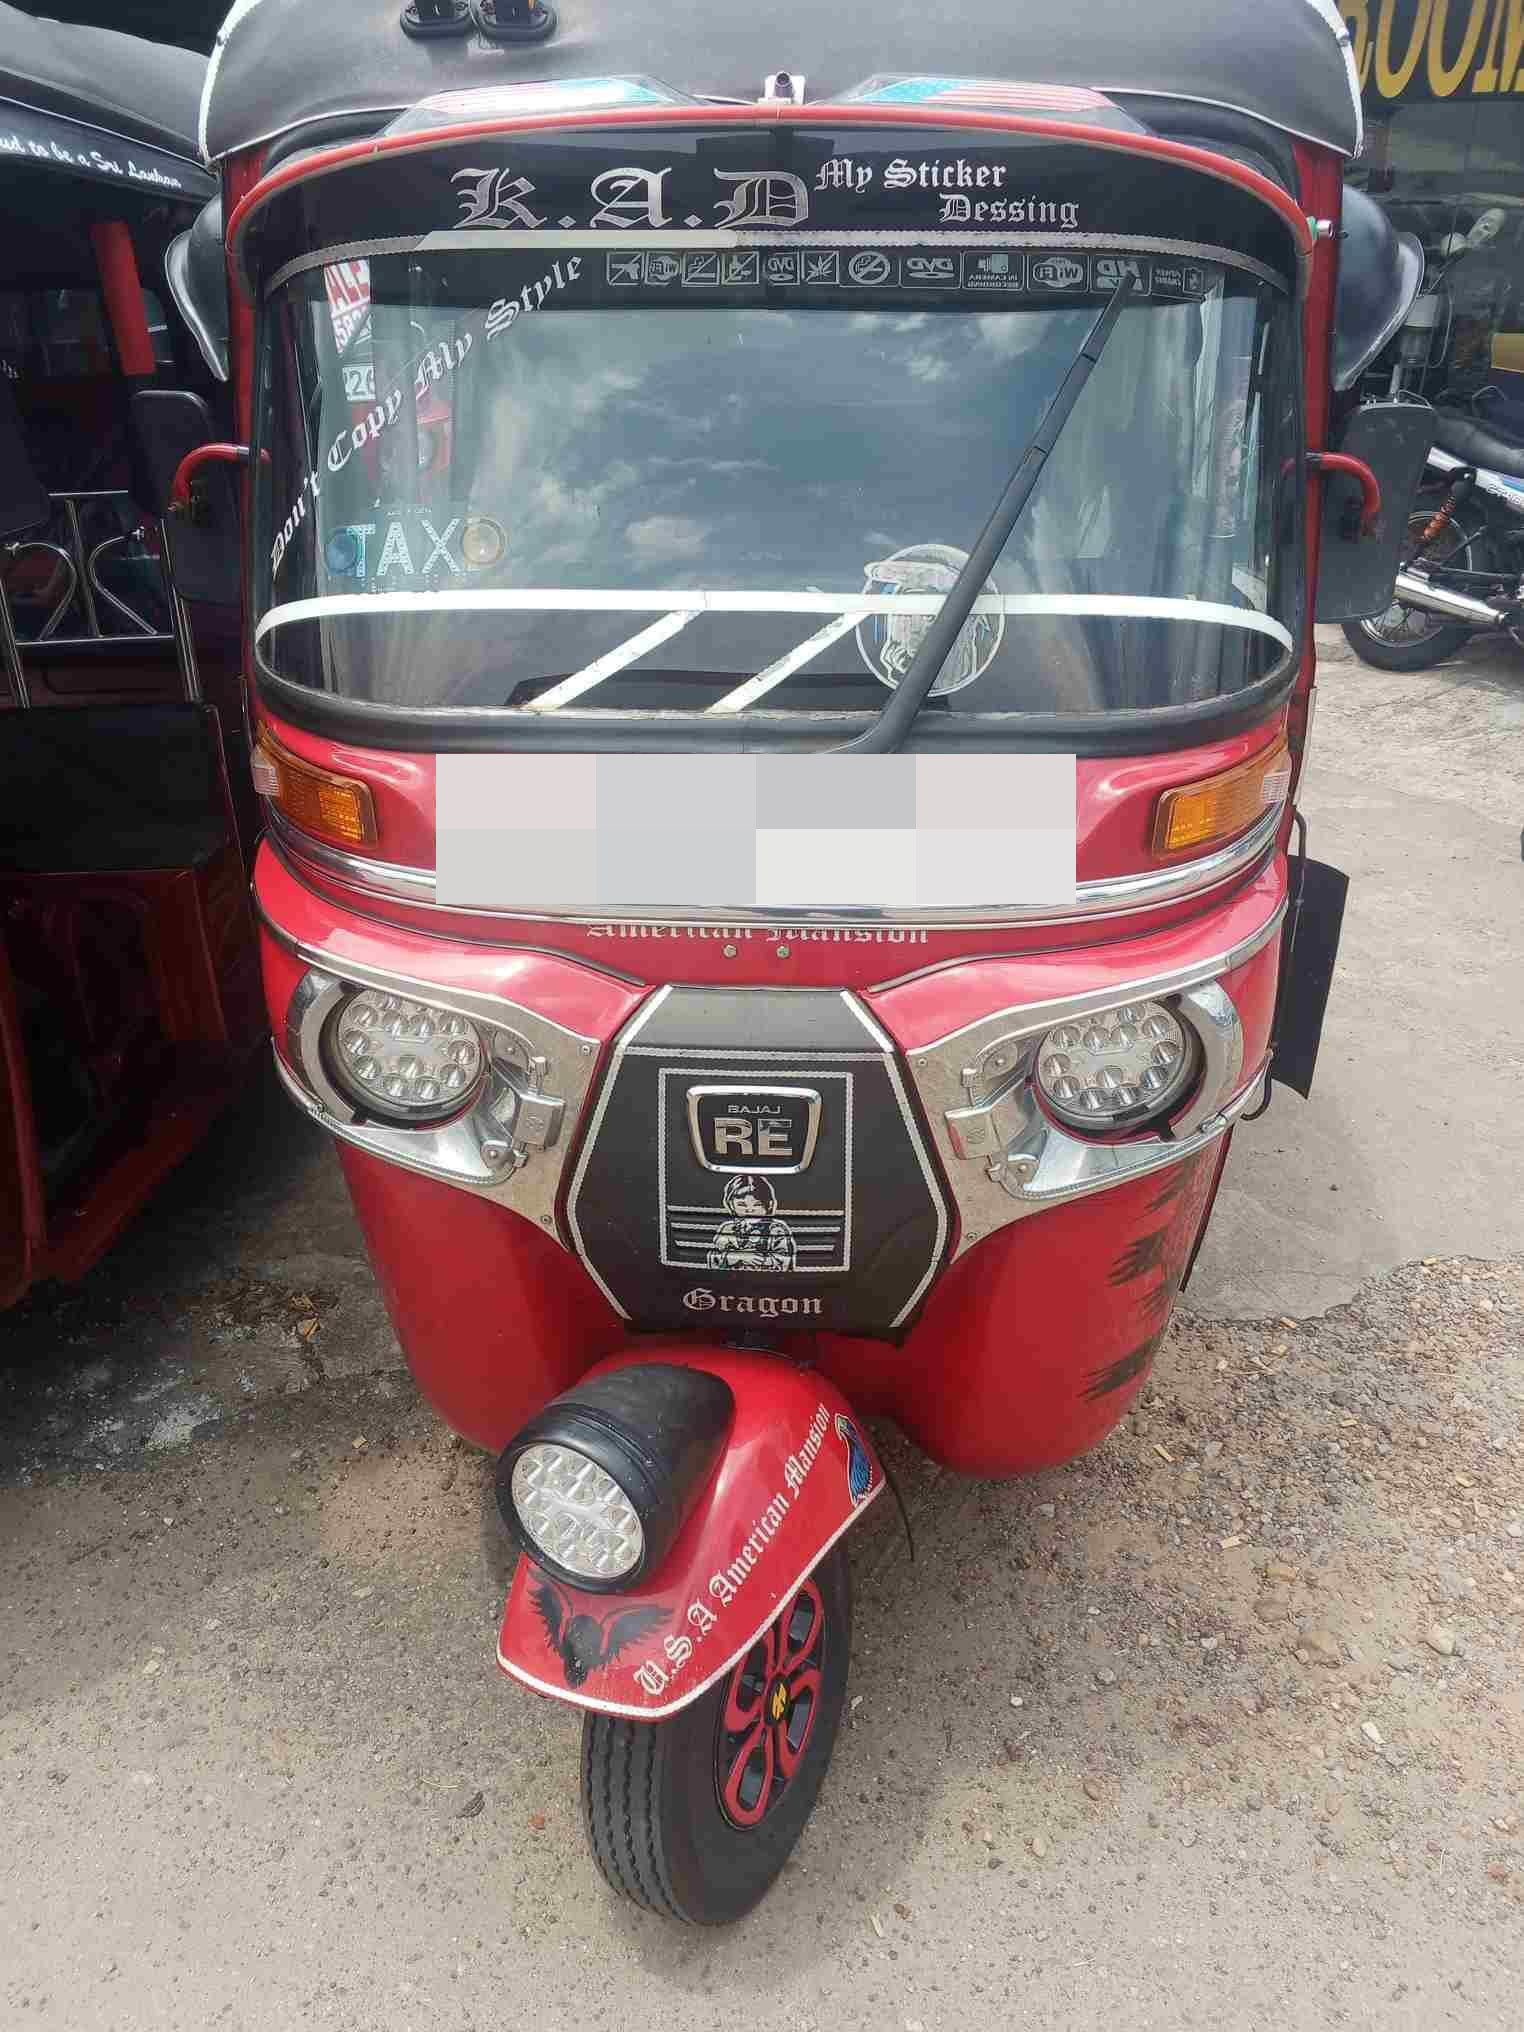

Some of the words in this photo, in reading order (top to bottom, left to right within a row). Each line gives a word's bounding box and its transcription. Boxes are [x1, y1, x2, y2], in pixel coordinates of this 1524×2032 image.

[814, 158, 873, 193] My
[883, 158, 1007, 189] Sticker
[939, 193, 1080, 229] Dessing
[327, 390, 402, 471] Copy
[485, 256, 582, 342] Style
[727, 1104, 780, 1114] BAJAJ
[714, 1117, 793, 1156] RE
[708, 1492, 790, 1608] American
[784, 1402, 831, 1500] Mansion
